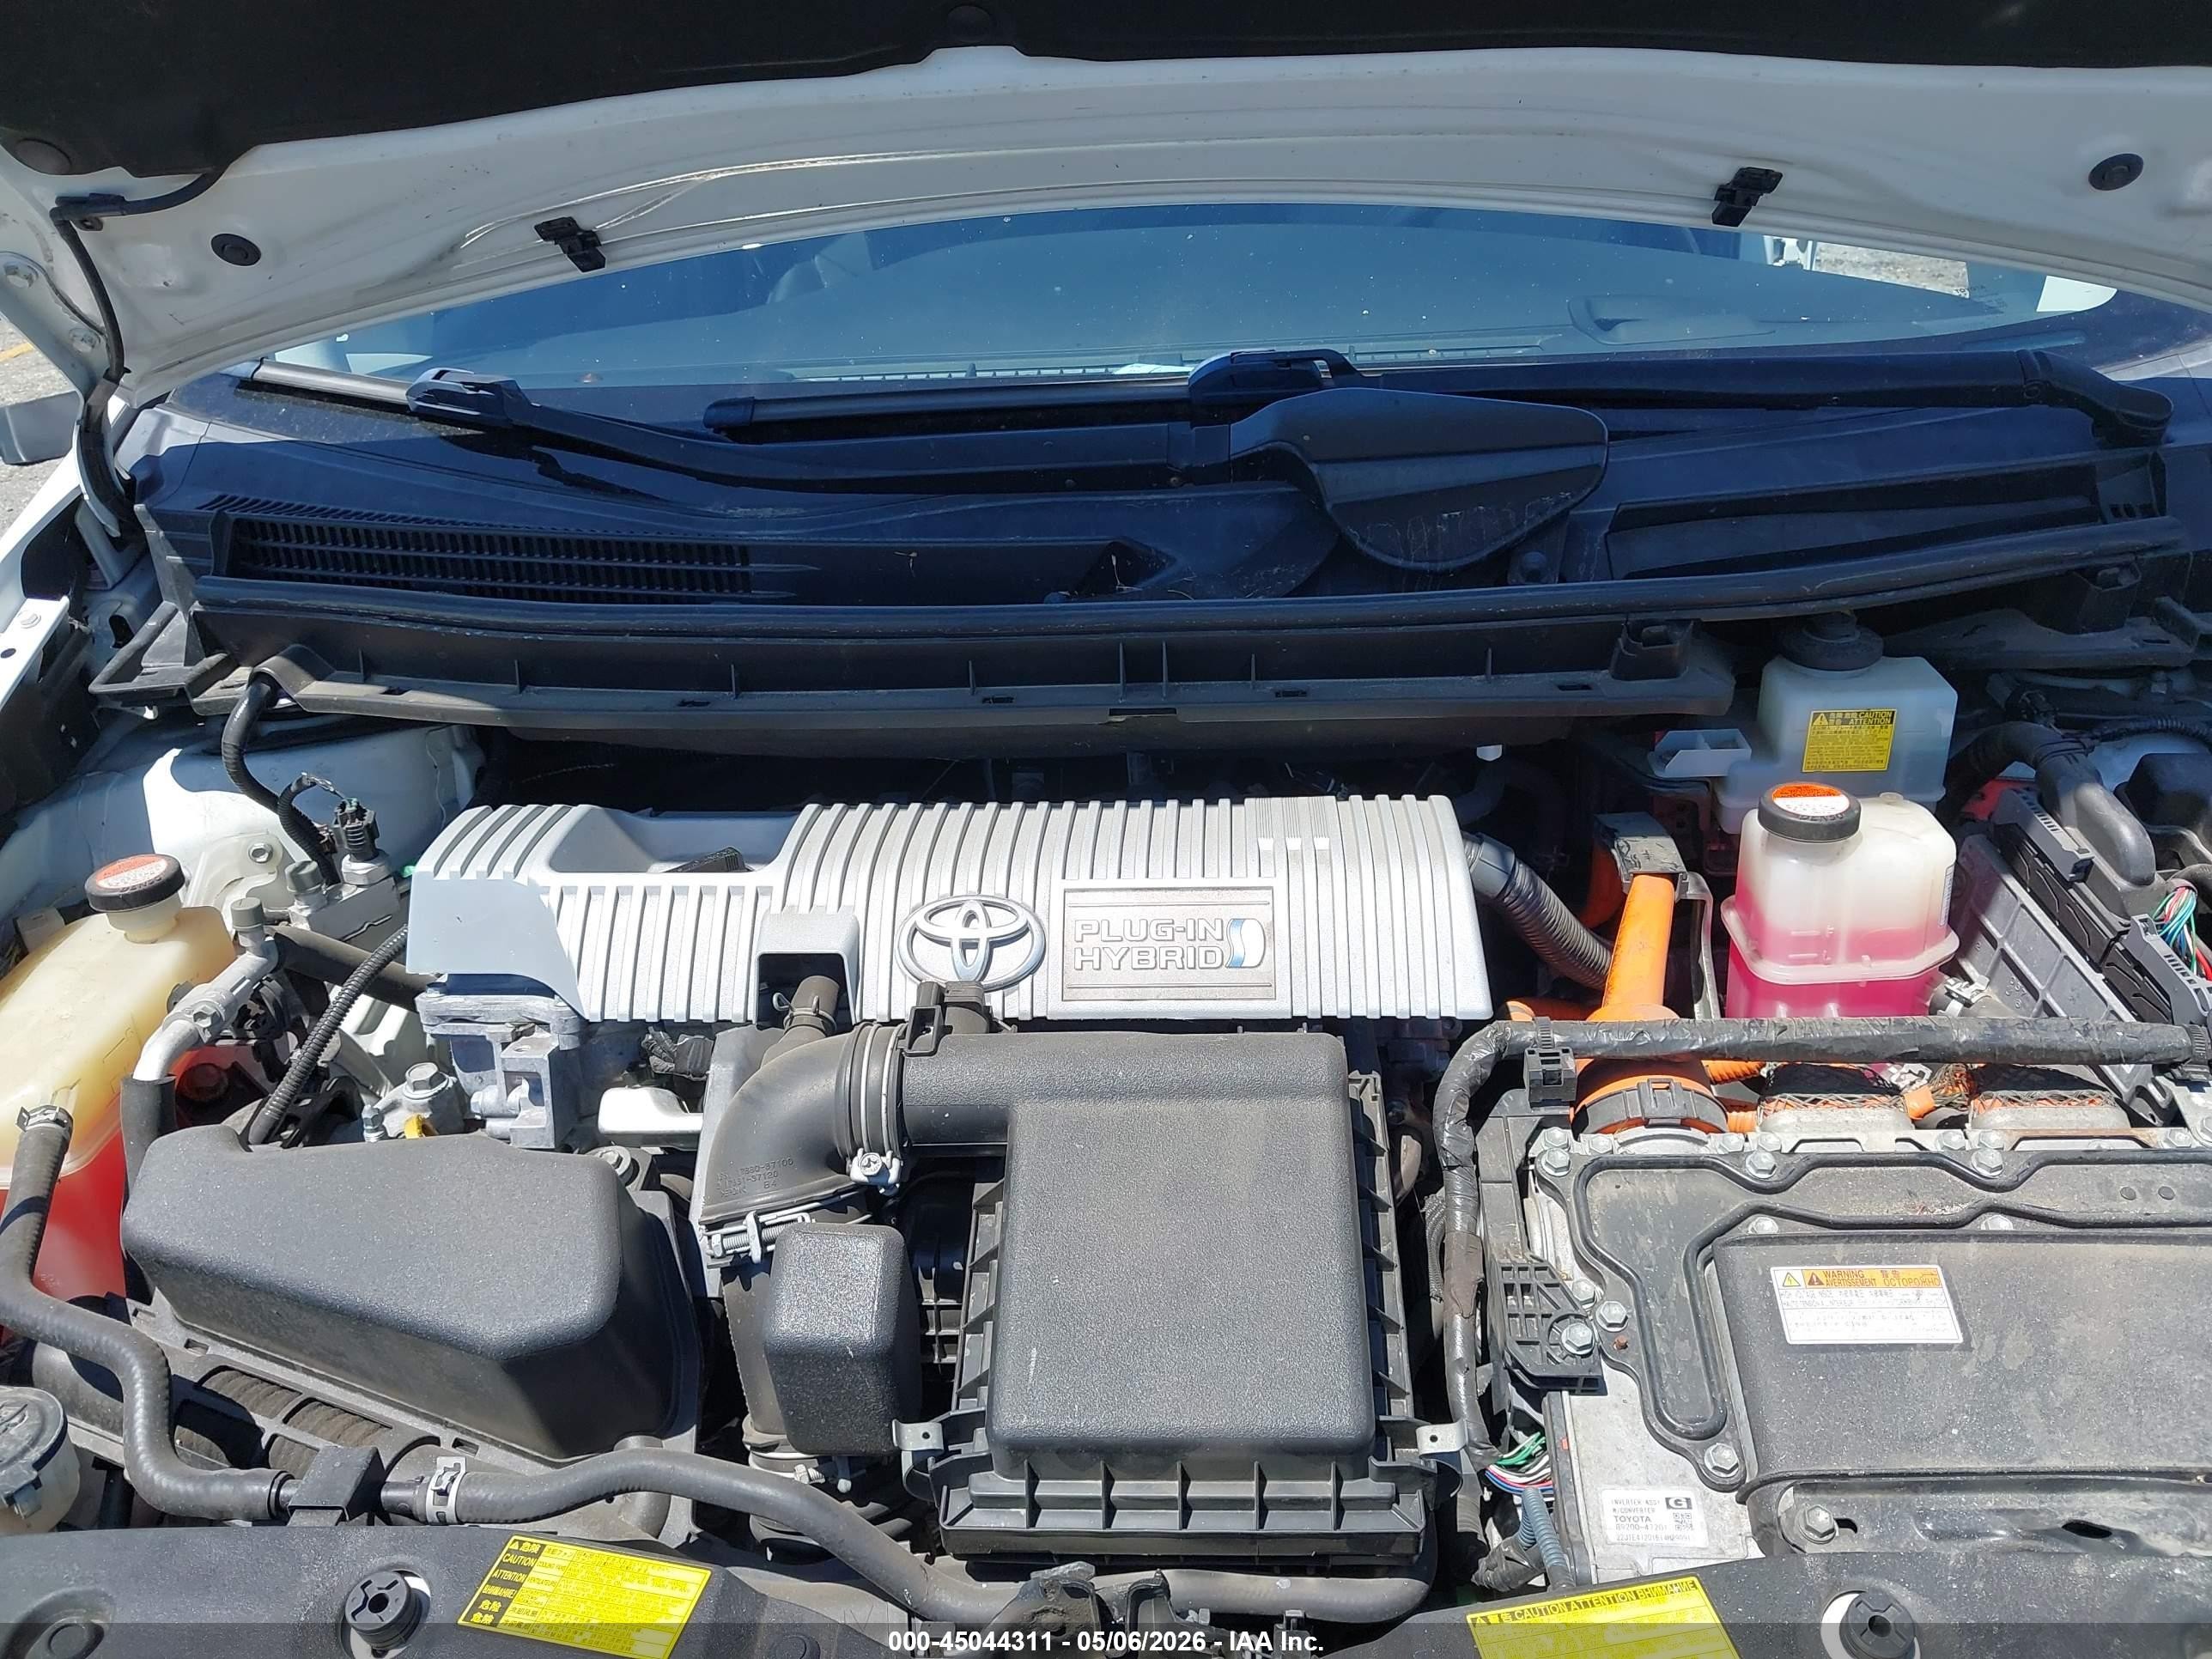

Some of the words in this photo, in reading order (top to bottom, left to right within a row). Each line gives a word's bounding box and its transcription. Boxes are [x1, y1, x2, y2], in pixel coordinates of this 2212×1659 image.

[1073, 918, 1223, 943] PLUG-IN
[1073, 945, 1224, 970] HYBRID
[1823, 1270, 1865, 1279] WARNING
[1825, 1278, 1877, 1286] AVERTISSEMENT
[1883, 1277, 1942, 1286] ОСТОРОЖНО
[1613, 1515, 1652, 1523] TOYOTA
[502, 1553, 537, 1567] CAUTION
[492, 1571, 528, 1583] ATTENTION
[1514, 1602, 1568, 1621] CAUTION
[1571, 1591, 1637, 1612] ATTENTION
